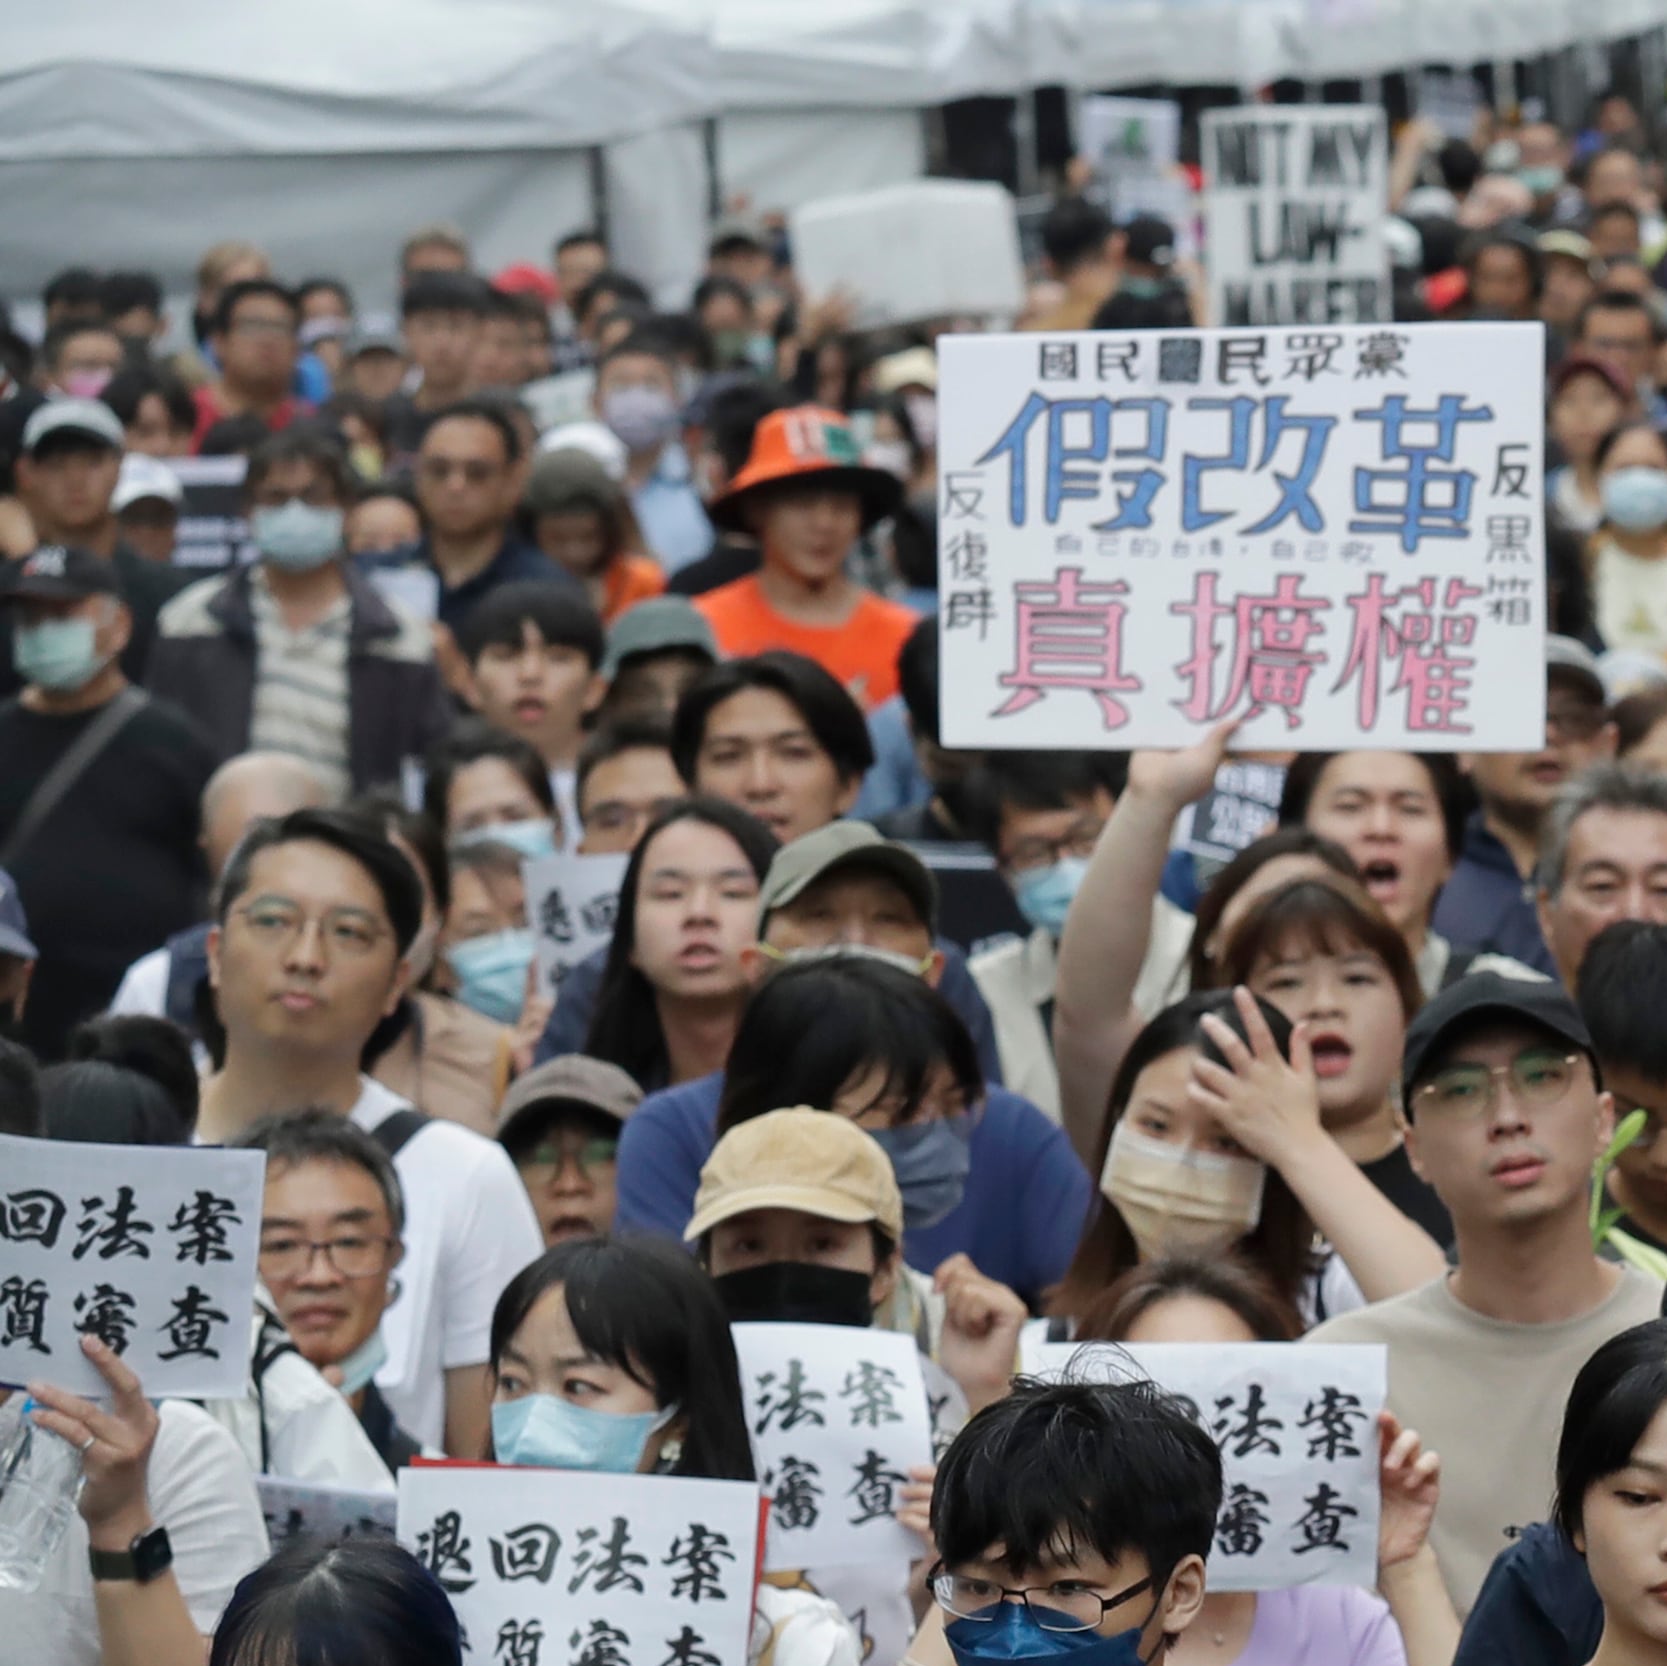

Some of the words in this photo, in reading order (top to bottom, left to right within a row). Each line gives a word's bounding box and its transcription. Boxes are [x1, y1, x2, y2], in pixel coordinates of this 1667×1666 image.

[974, 391, 1494, 554] 假改革
[988, 565, 1485, 734] 真擴權
[413, 1509, 737, 1604] 退回法案
